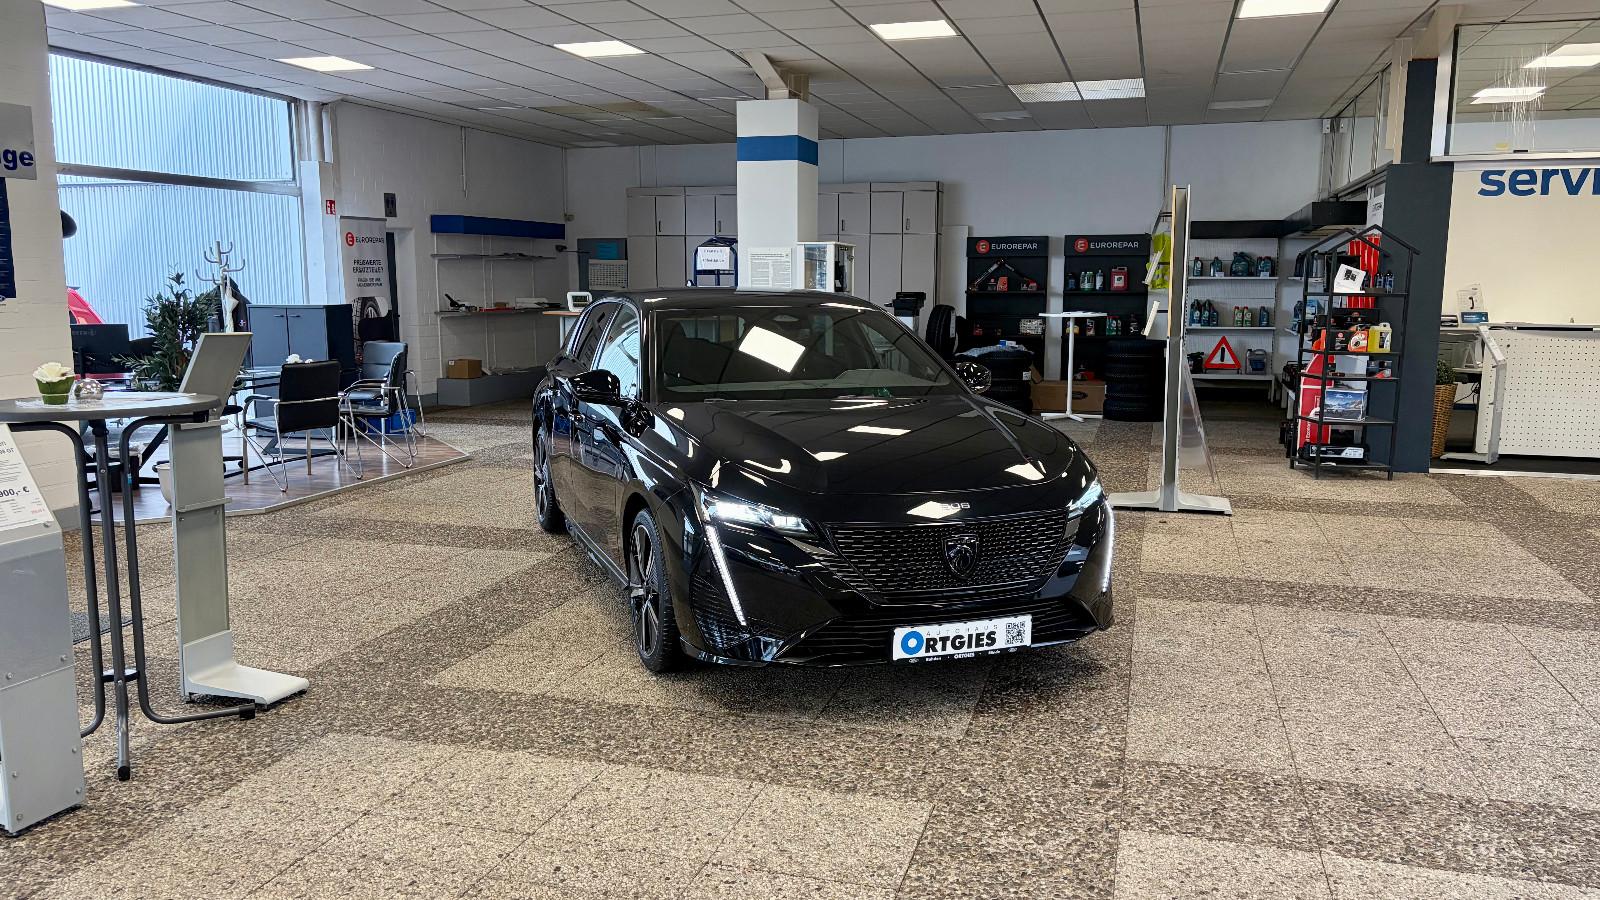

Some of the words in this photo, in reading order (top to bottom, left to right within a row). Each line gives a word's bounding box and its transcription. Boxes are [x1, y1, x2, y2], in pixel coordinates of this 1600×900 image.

[0, 149, 34, 171] ge
[1090, 241, 1139, 249] EUROREPAR
[926, 624, 998, 637] AUTOHAUS
[901, 630, 997, 655] ORTGIES
